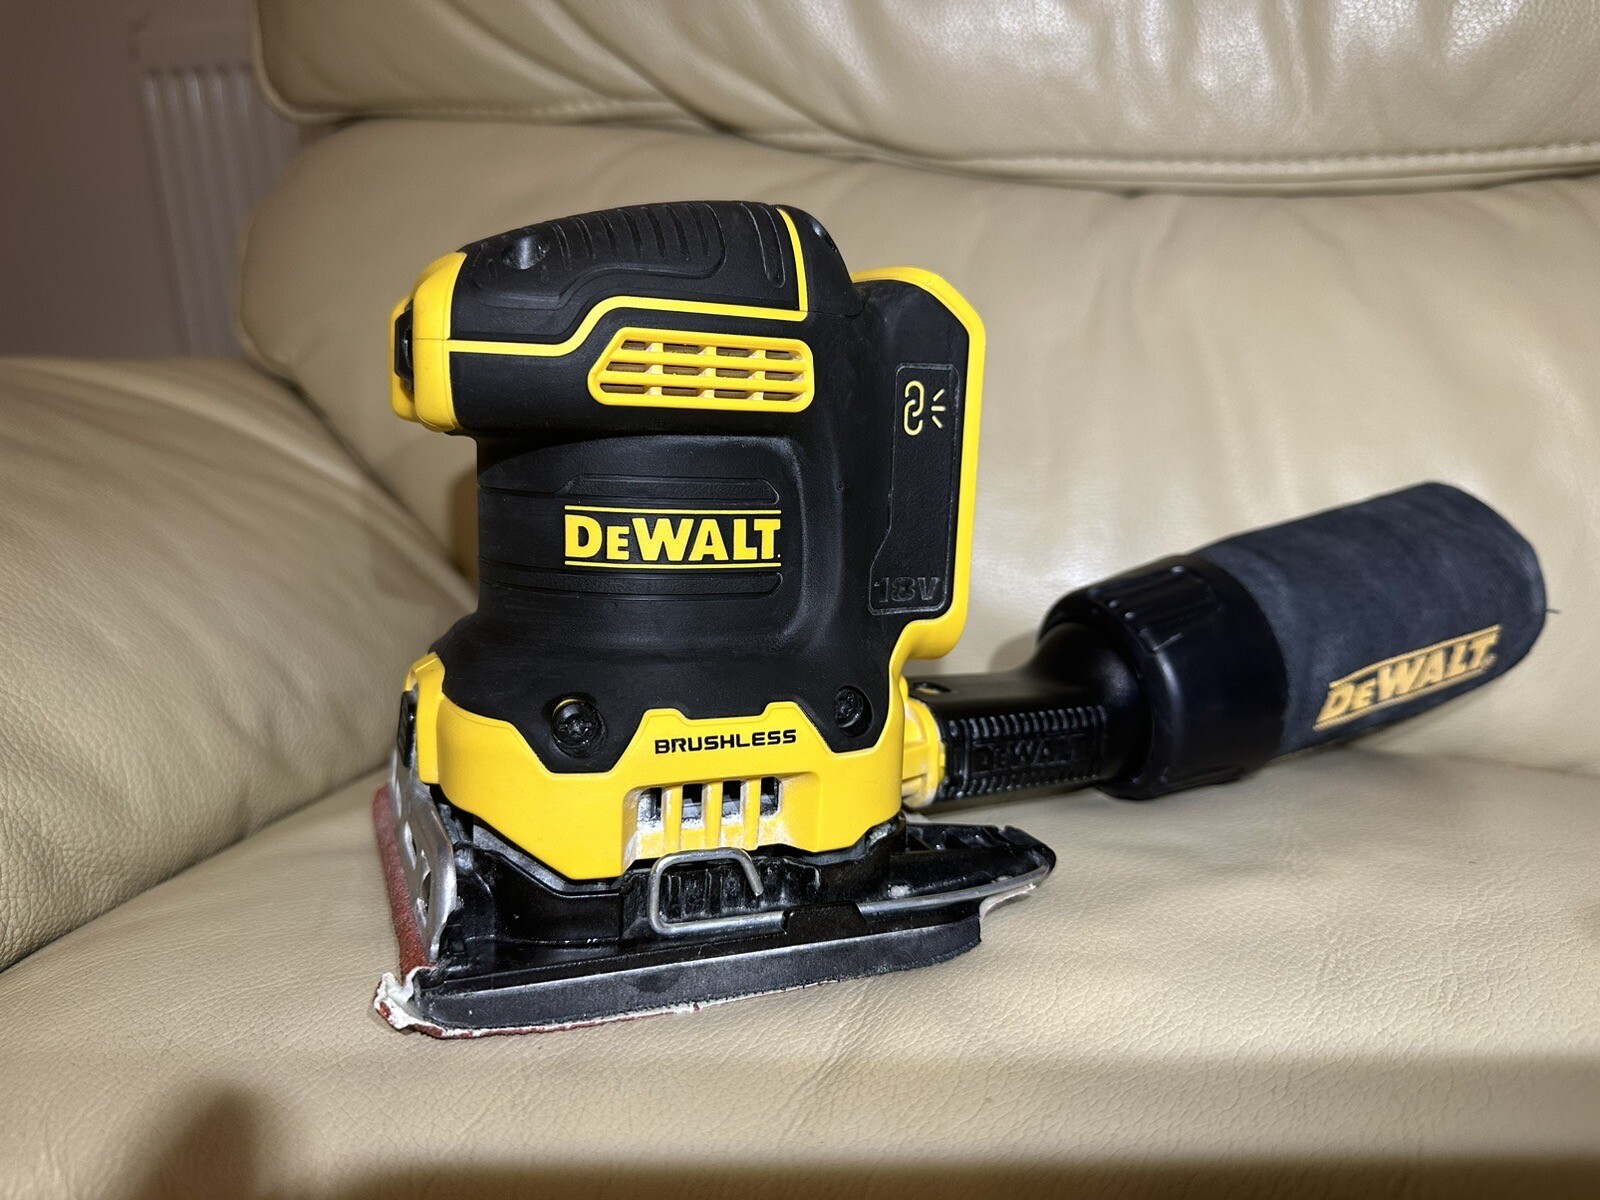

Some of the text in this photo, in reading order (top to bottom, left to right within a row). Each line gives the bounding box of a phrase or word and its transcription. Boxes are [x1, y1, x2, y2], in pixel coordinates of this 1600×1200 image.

[564, 513, 781, 562] DEWALT
[878, 576, 939, 603] 18V
[1315, 632, 1499, 724] DEWALT
[654, 729, 797, 754] BRUSHLESS
